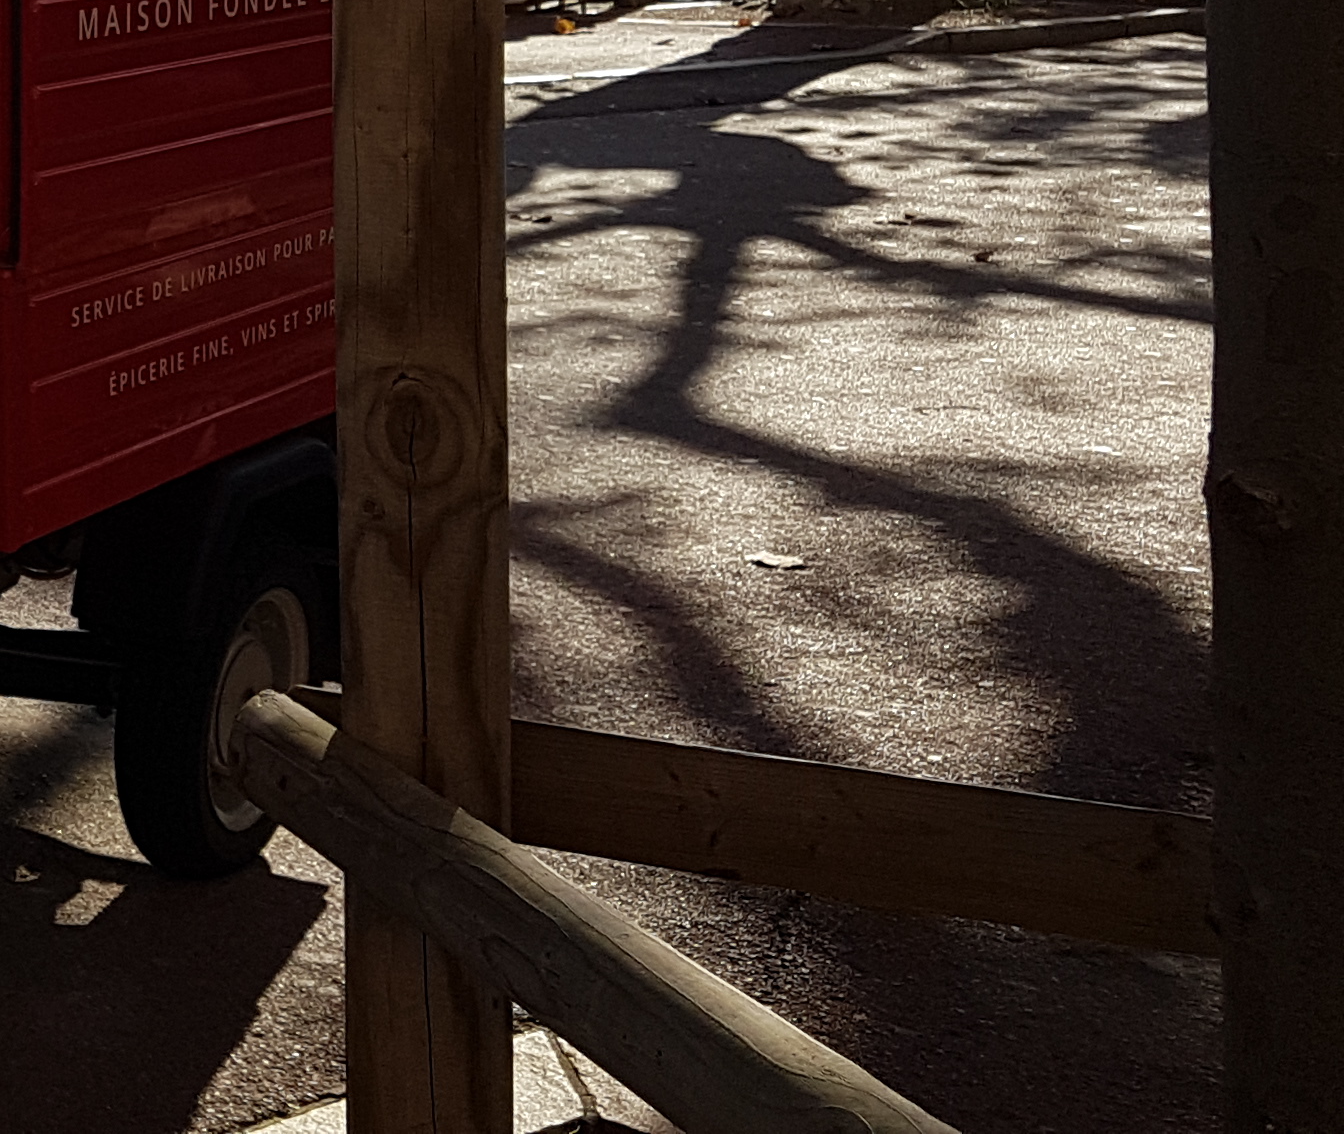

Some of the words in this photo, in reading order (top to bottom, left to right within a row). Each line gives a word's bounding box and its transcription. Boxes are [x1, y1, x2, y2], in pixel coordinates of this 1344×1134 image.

[71, 285, 145, 329] SERVICE
[152, 276, 173, 302] DE
[180, 249, 267, 292] LIVRAISON
[273, 232, 313, 262] POUR
[109, 351, 185, 397] ÉPICERIE
[192, 336, 234, 366] FINE,
[241, 318, 277, 348] VINS
[283, 310, 300, 334] ET
